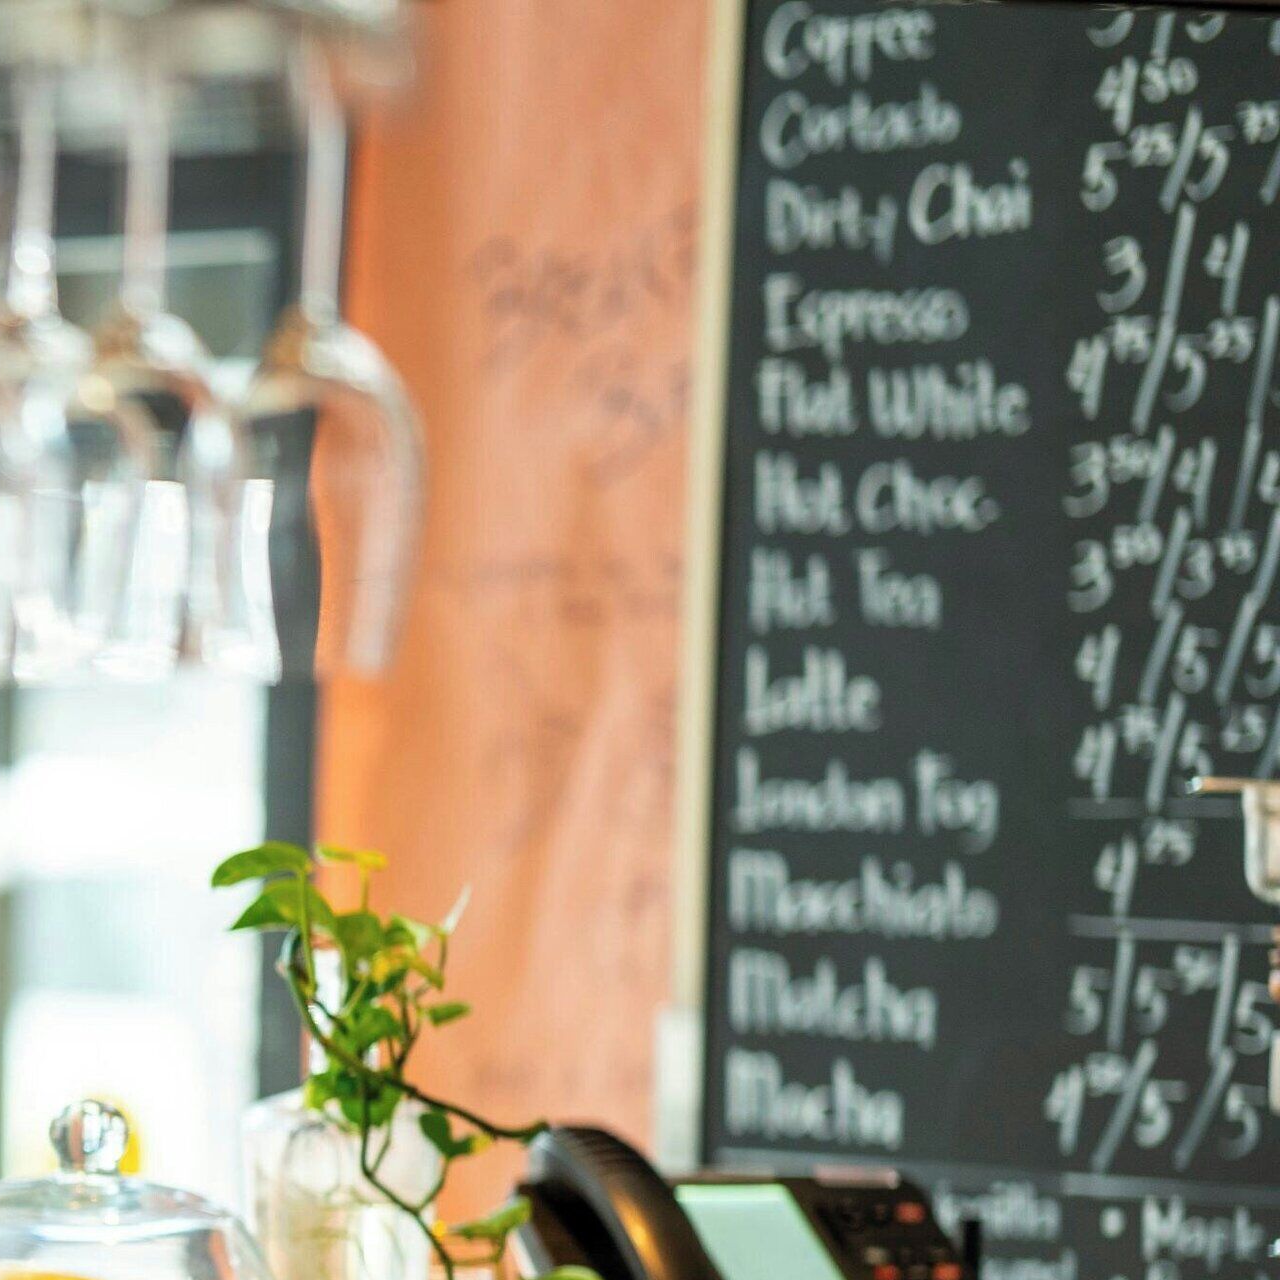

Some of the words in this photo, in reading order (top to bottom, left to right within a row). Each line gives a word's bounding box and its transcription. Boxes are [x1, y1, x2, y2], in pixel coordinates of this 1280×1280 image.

[762, 0, 936, 86] Coffee
[759, 81, 963, 170] Cortado
[765, 178, 898, 267] Dirty
[908, 157, 1032, 245] Chai
[763, 270, 970, 362] Espresso
[754, 354, 858, 438] Flat
[867, 355, 1032, 440] White
[753, 448, 852, 536] Hot
[855, 456, 1001, 536] Choc
[748, 545, 838, 636] Hot
[852, 546, 943, 632] Tea
[744, 643, 883, 737] Latte
[733, 745, 906, 835] London
[910, 745, 1000, 856] Fog
[729, 946, 938, 1052] Matcha
[723, 1044, 904, 1151] Mocha
